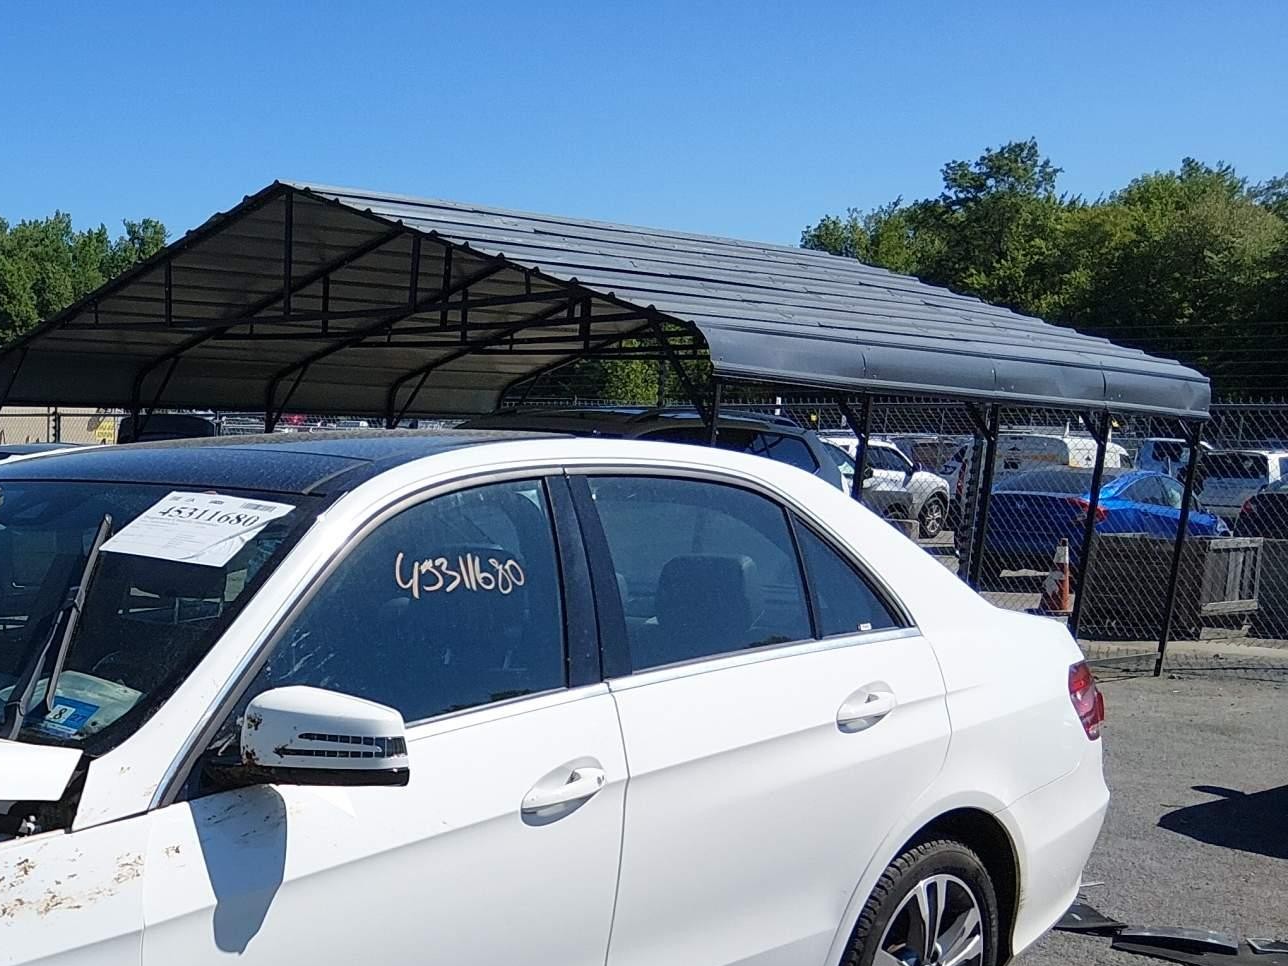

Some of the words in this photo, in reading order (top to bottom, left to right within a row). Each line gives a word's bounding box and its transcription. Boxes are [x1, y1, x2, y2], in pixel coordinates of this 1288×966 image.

[158, 505, 260, 527] 45311680
[394, 552, 525, 600] 45311680
[52, 707, 68, 720] 8
